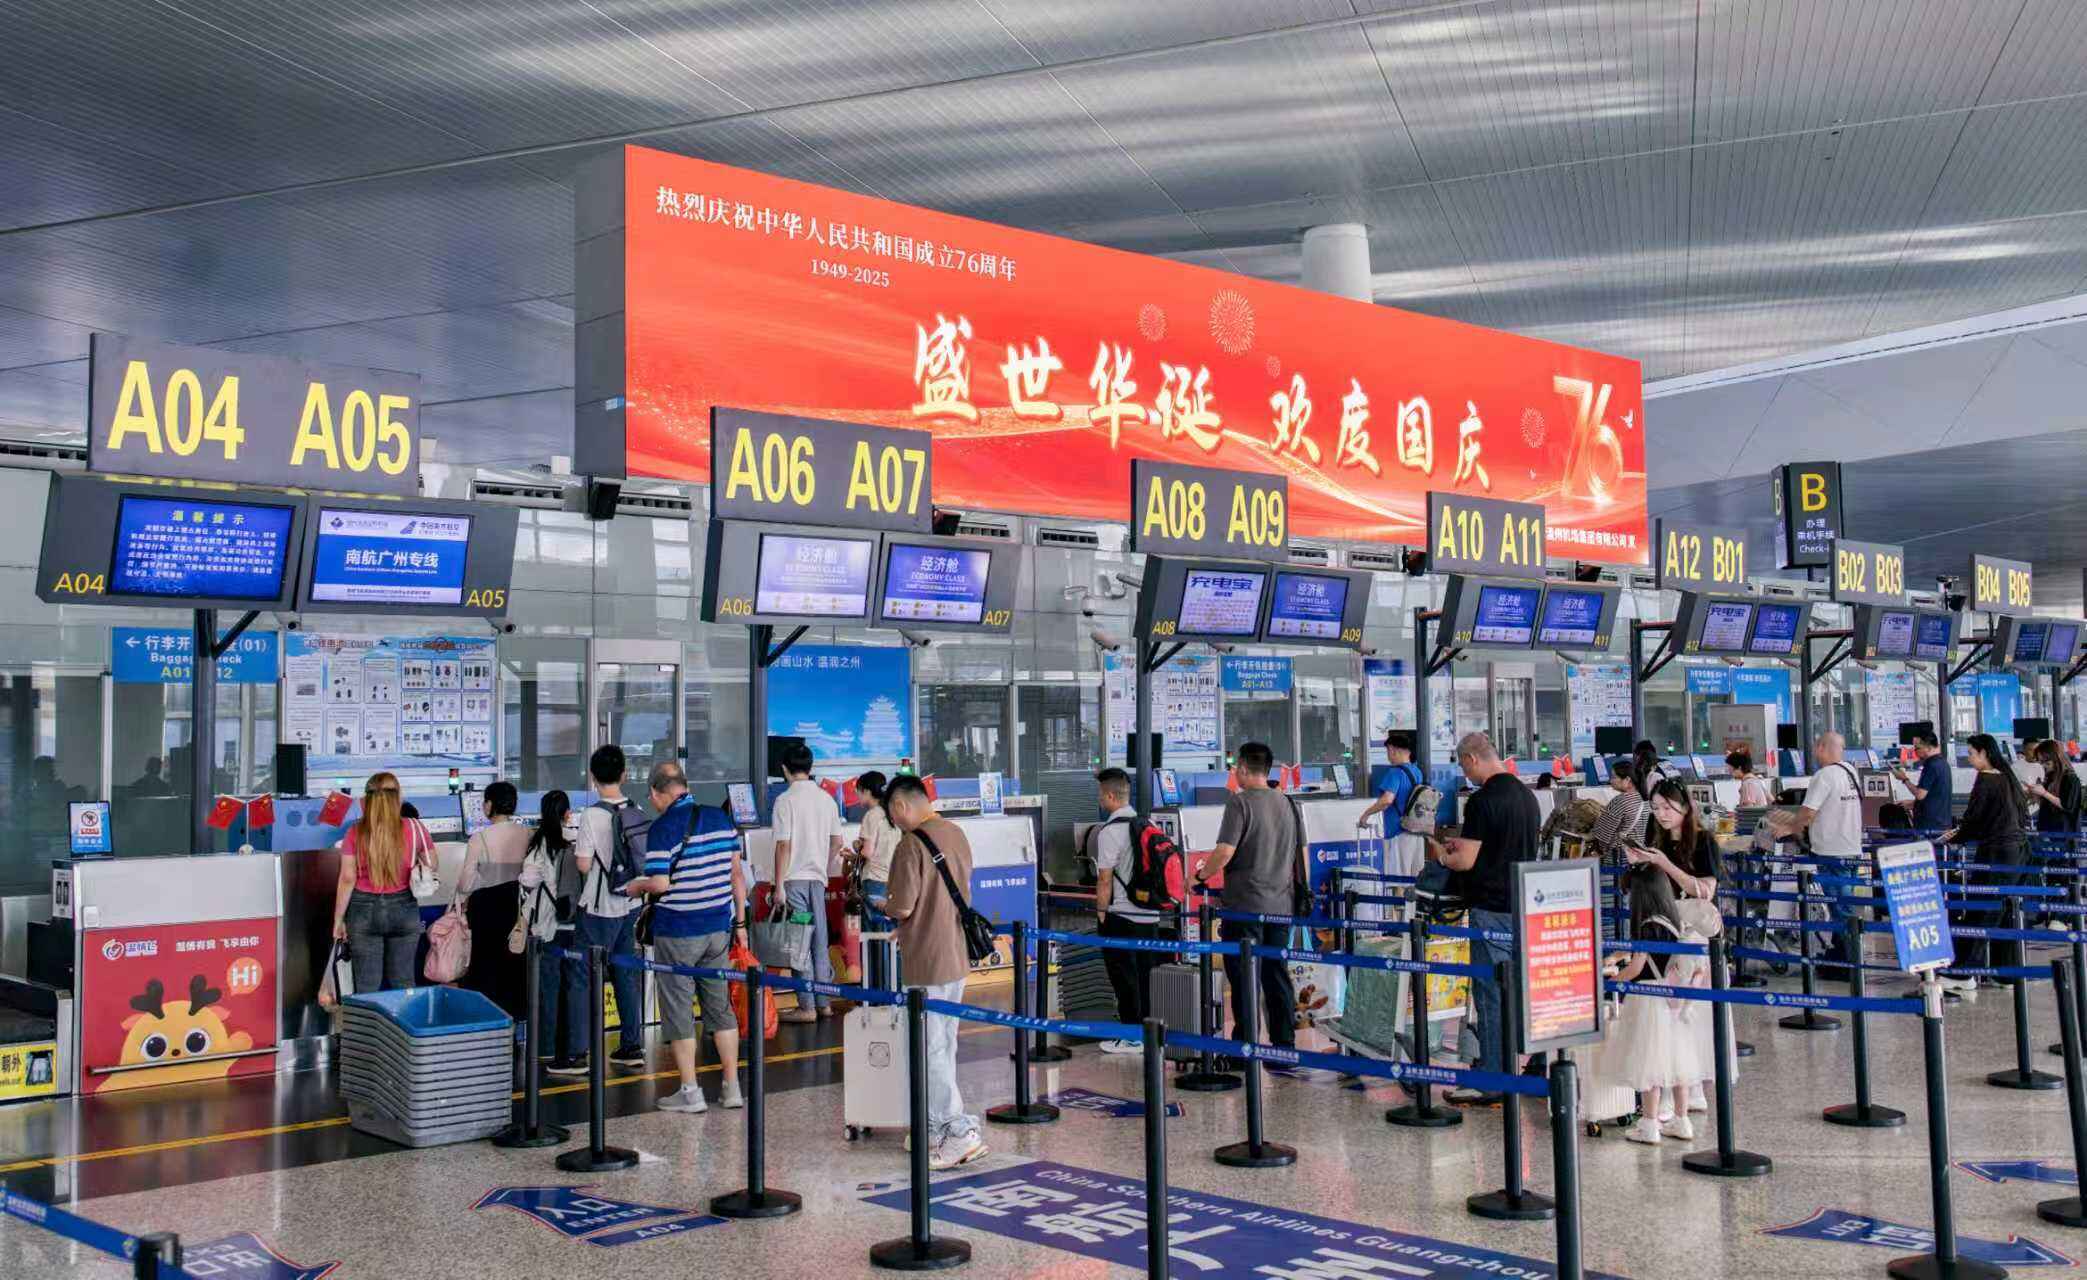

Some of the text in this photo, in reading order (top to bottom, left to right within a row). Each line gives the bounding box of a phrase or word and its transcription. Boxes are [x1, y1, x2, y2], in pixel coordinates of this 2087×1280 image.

[656, 185, 1017, 282] 热烈庆祝中华人民共和国成立76周年
[811, 258, 890, 288] 1949-2025
[912, 313, 1491, 490] 盛世华诞 欢度国庆
[107, 360, 410, 475] A04 A05
[1552, 374, 1625, 502] 76
[726, 427, 926, 515] A06 A07
[1800, 473, 1827, 512] B
[1143, 476, 1285, 547] A08 A09
[1437, 505, 1541, 567] A10 A11
[345, 549, 439, 568] 南航广州专线
[920, 555, 959, 572] 经济舱
[1664, 531, 1744, 584] A12 B01
[53, 572, 105, 594] A04
[1191, 576, 1253, 590] 充电宝
[1838, 549, 1902, 596] B02 B03
[1977, 564, 2030, 607] B04 B05
[466, 589, 505, 608] A05
[720, 598, 752, 616] A06
[984, 610, 1010, 626] A07
[1152, 621, 1175, 635] A08
[1341, 628, 1361, 642] A09
[1908, 925, 1940, 950] A05
[232, 964, 257, 986] Hi
[536, 1198, 618, 1219] 入口
[566, 1206, 656, 1229] ENTER
[635, 1223, 685, 1239] A04
[1036, 1169, 1107, 1190] China
[1233, 1209, 1352, 1241] Airlines
[1354, 1234, 1550, 1280] Guangzhou
